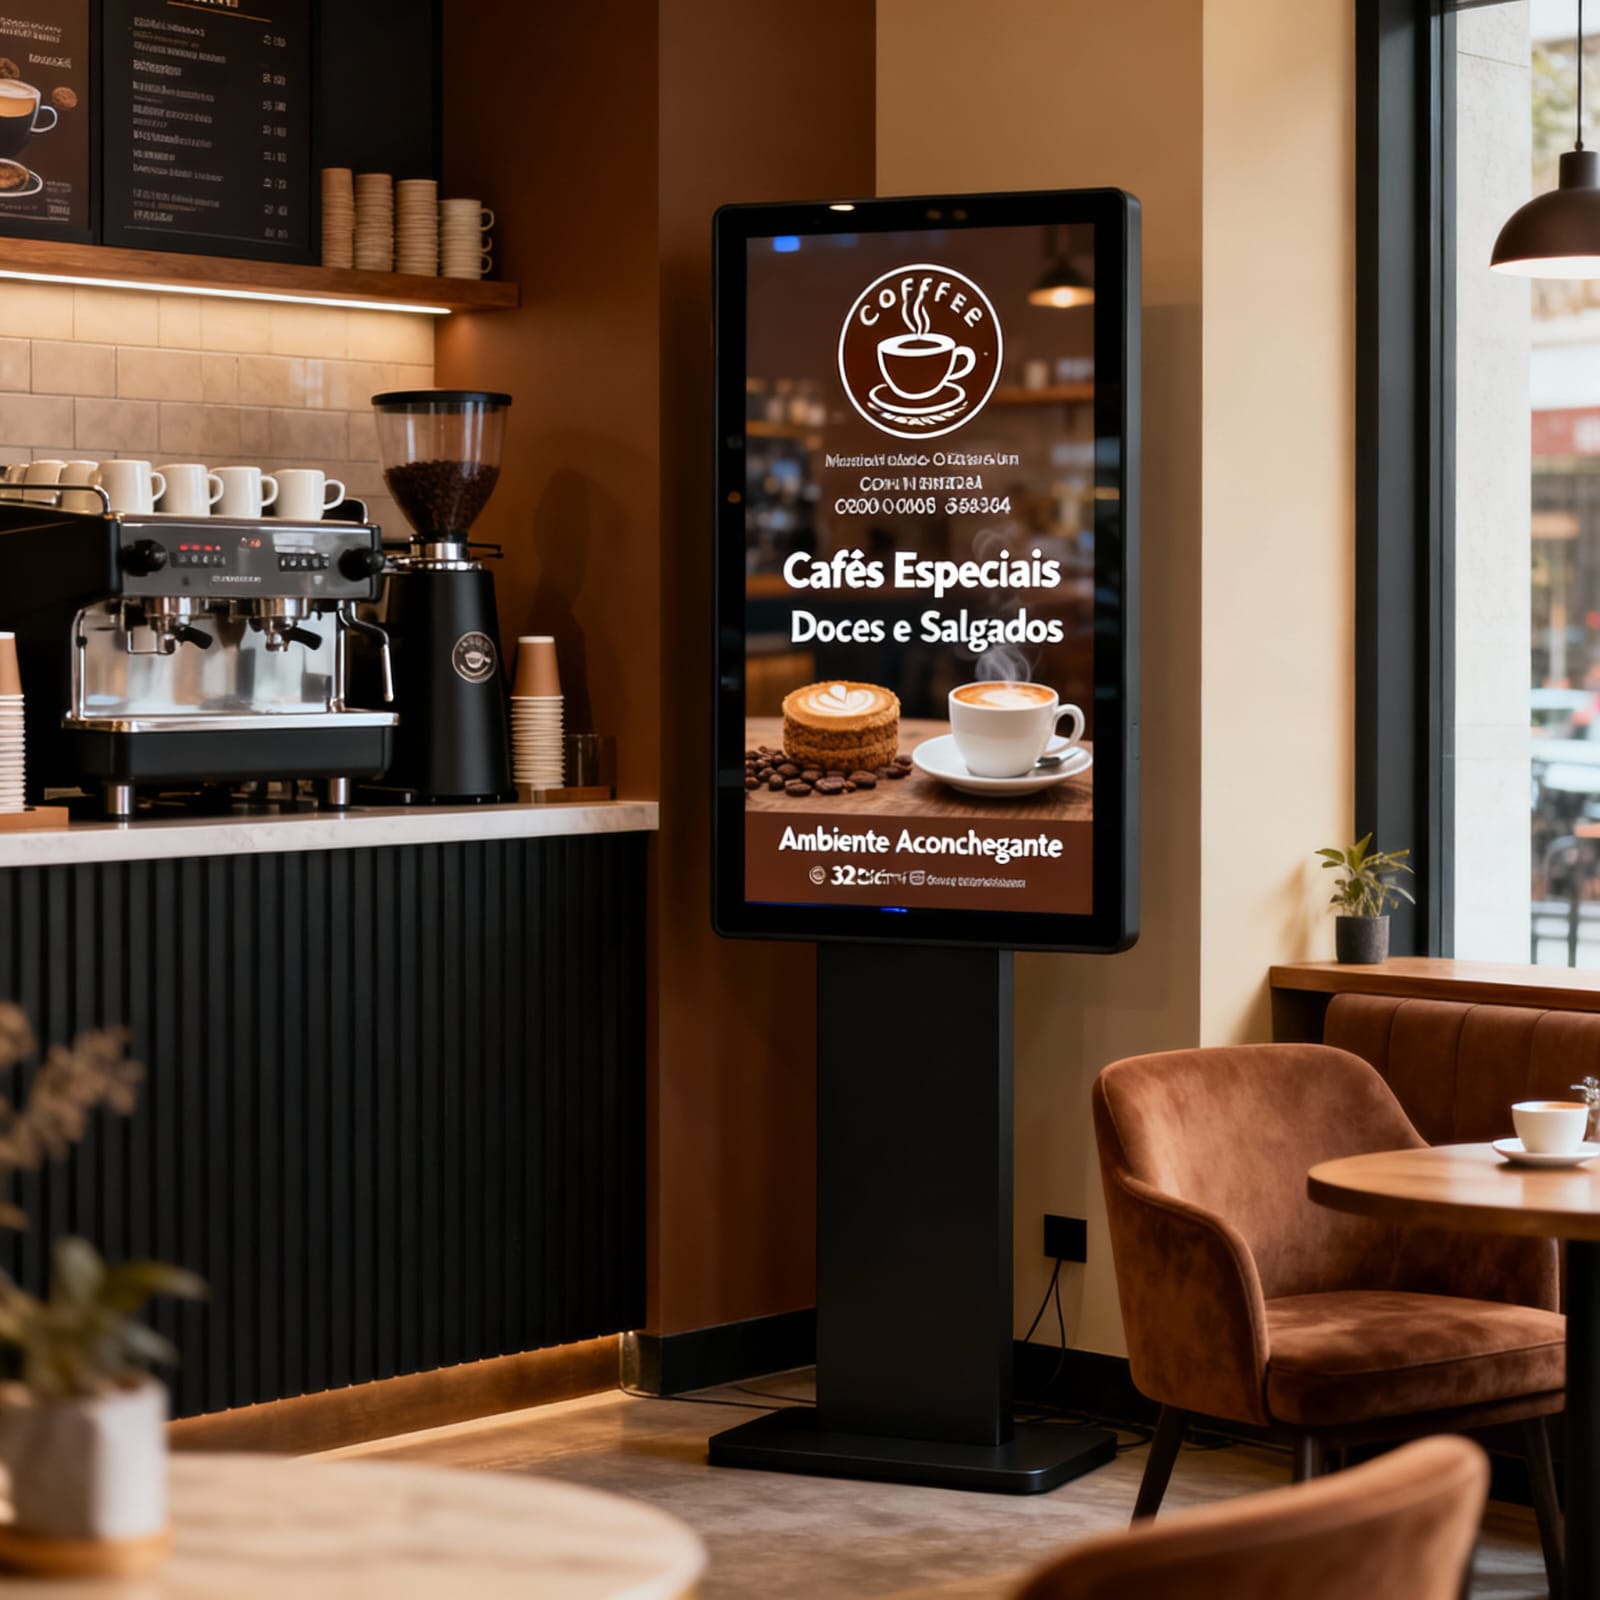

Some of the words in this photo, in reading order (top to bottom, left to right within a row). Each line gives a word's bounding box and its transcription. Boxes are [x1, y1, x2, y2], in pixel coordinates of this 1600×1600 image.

[894, 548, 1061, 598] Especiais
[791, 610, 886, 643] Doces
[893, 620, 912, 643] e
[920, 608, 1064, 652] Salgados
[778, 825, 891, 853] Ambiente
[895, 829, 1064, 864] Aconchegante
